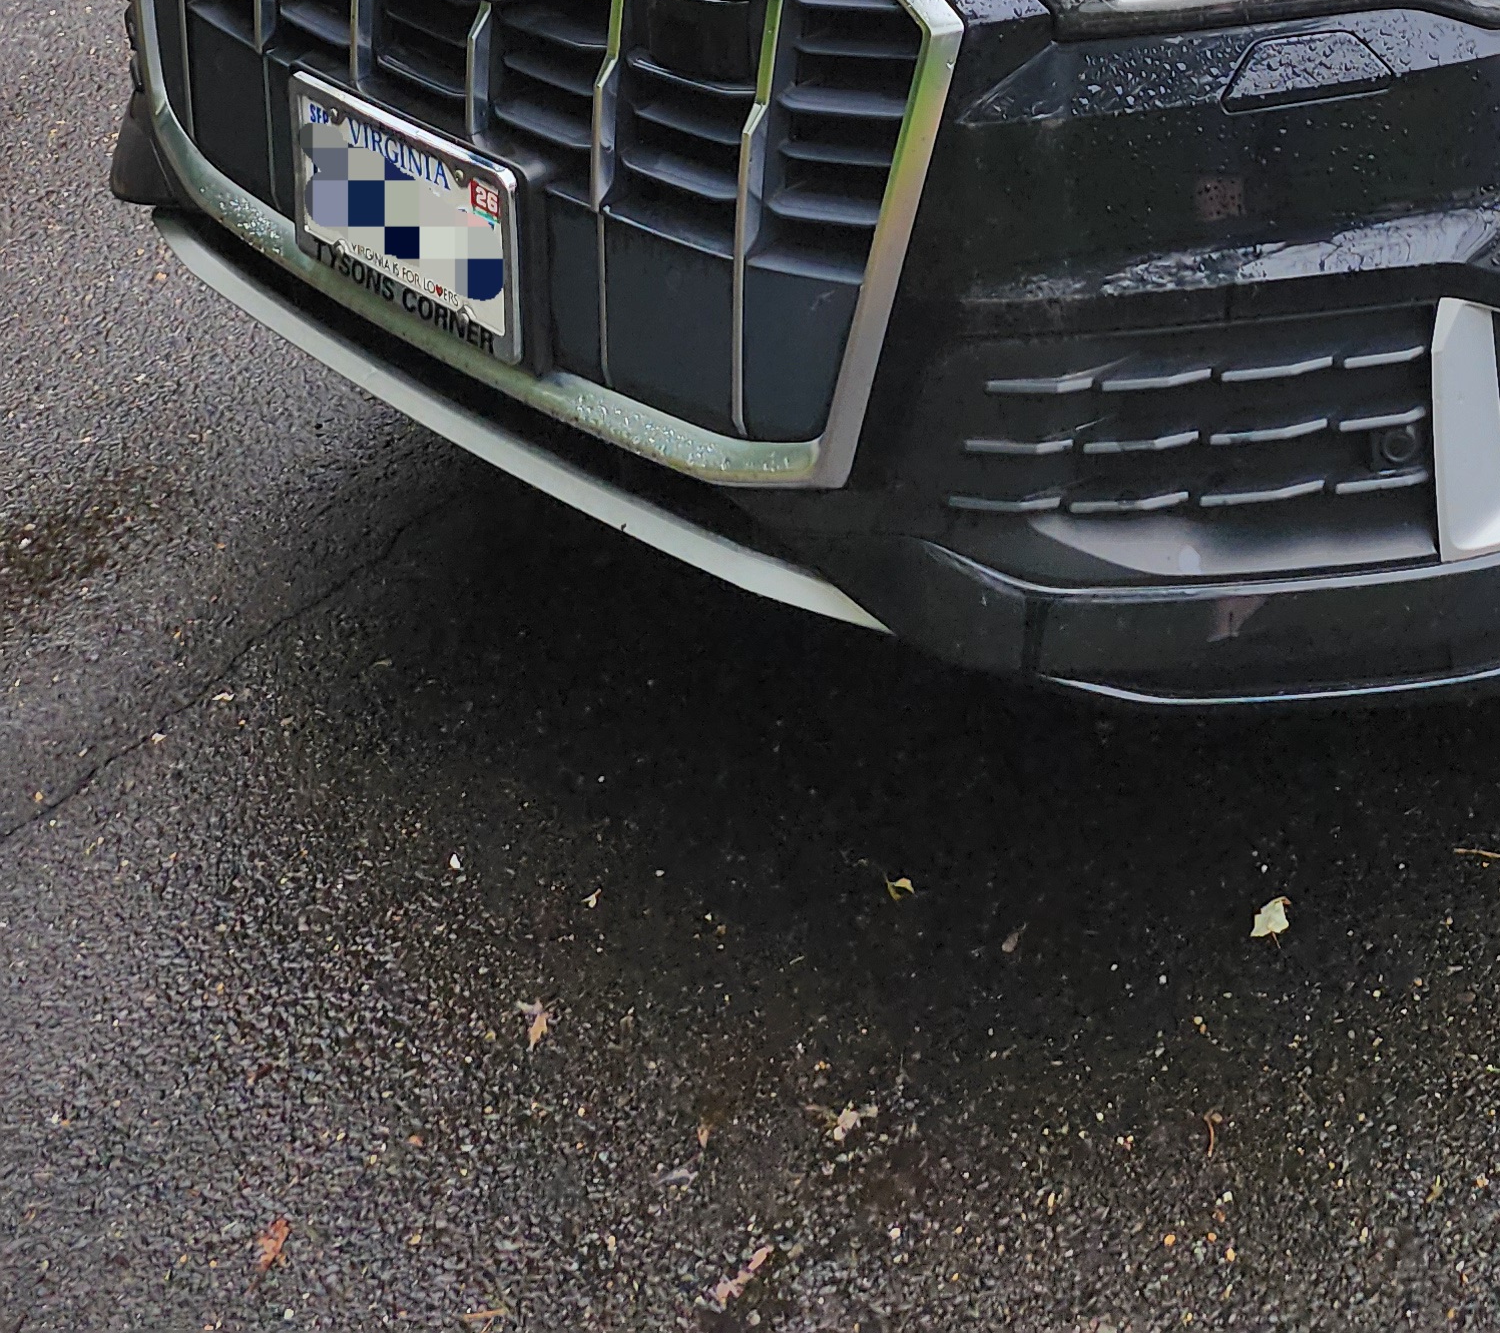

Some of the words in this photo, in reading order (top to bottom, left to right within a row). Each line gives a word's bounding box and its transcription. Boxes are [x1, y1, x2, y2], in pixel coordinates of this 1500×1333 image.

[347, 117, 451, 191] VIRGINIA
[475, 185, 499, 214] 26
[351, 242, 391, 272] VIRGINIA
[402, 267, 422, 288] FOR
[313, 238, 394, 301] TYSONS
[402, 287, 494, 355] CORNER
